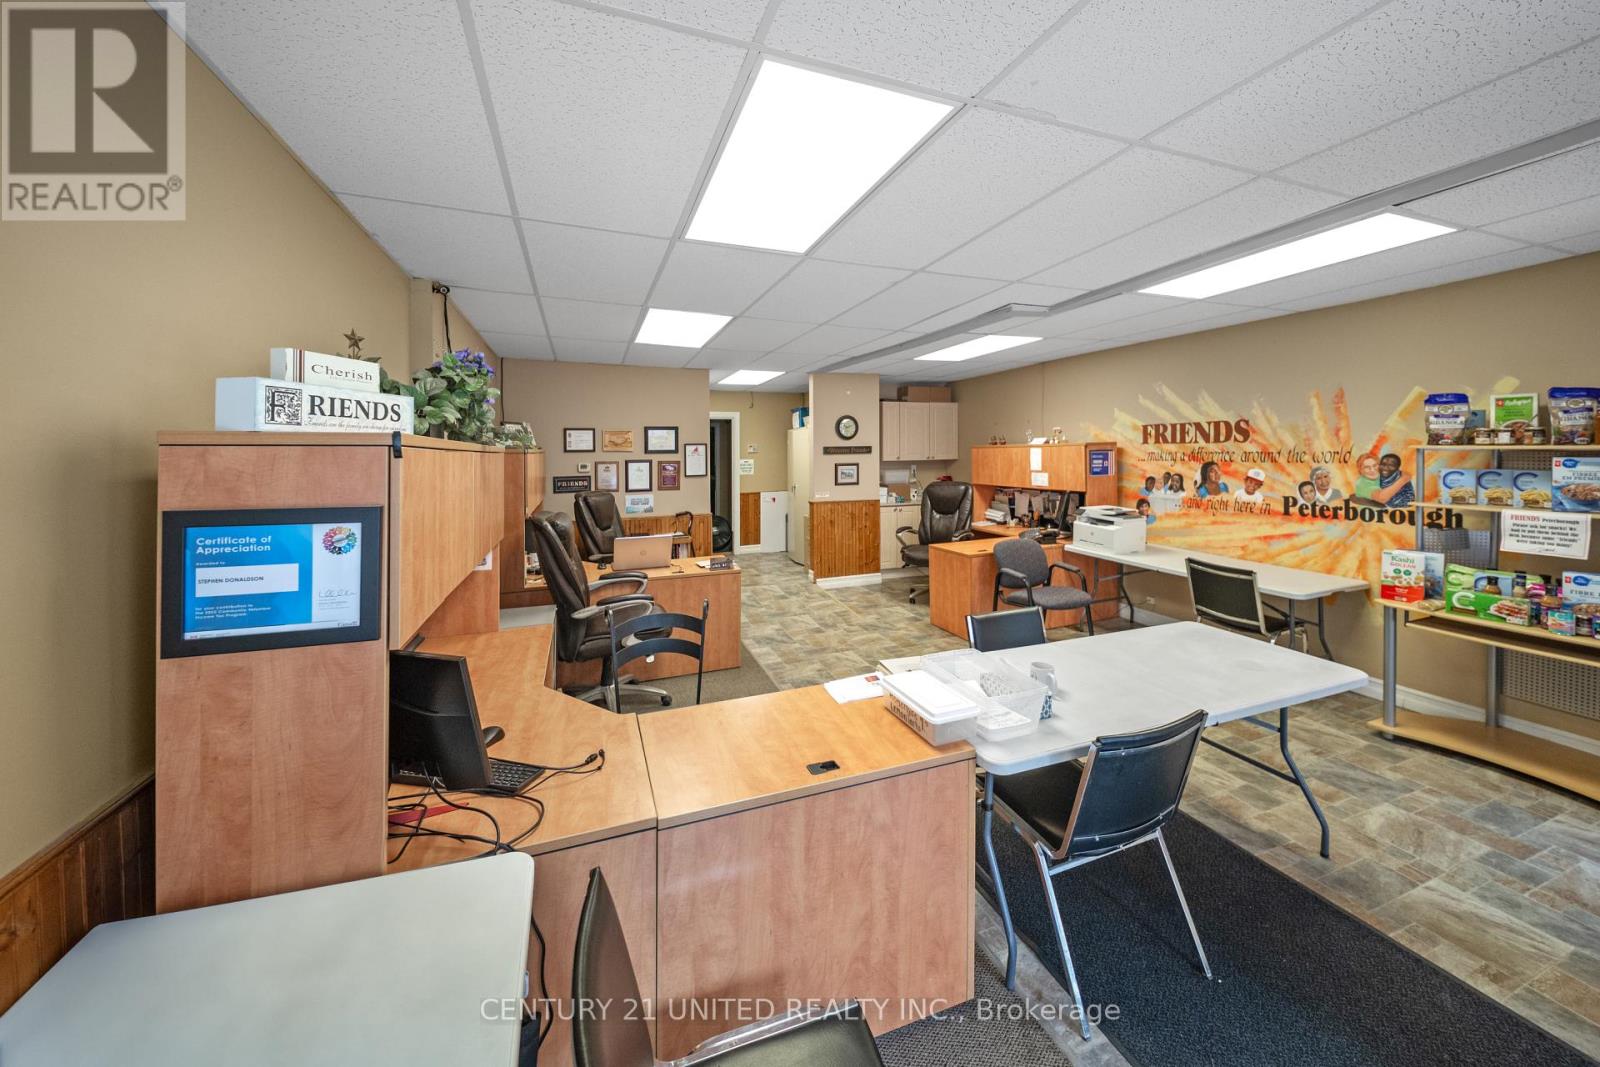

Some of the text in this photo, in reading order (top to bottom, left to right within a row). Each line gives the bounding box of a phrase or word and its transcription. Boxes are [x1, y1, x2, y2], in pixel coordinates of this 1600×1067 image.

[311, 363, 373, 381] Cherish
[1141, 418, 1251, 445] FRIENDS
[1179, 452, 1185, 461] a
[1187, 448, 1236, 465] difference
[1240, 450, 1281, 464] around
[1286, 447, 1306, 463] the
[1312, 447, 1352, 464] world
[1204, 498, 1229, 516] right
[1233, 500, 1257, 514] here
[1259, 502, 1272, 515] in
[1510, 514, 1540, 522] FRIENDS
[196, 535, 272, 546] Certificate of
[195, 544, 271, 555] Appreciation
[1391, 555, 1415, 564] Kashi
